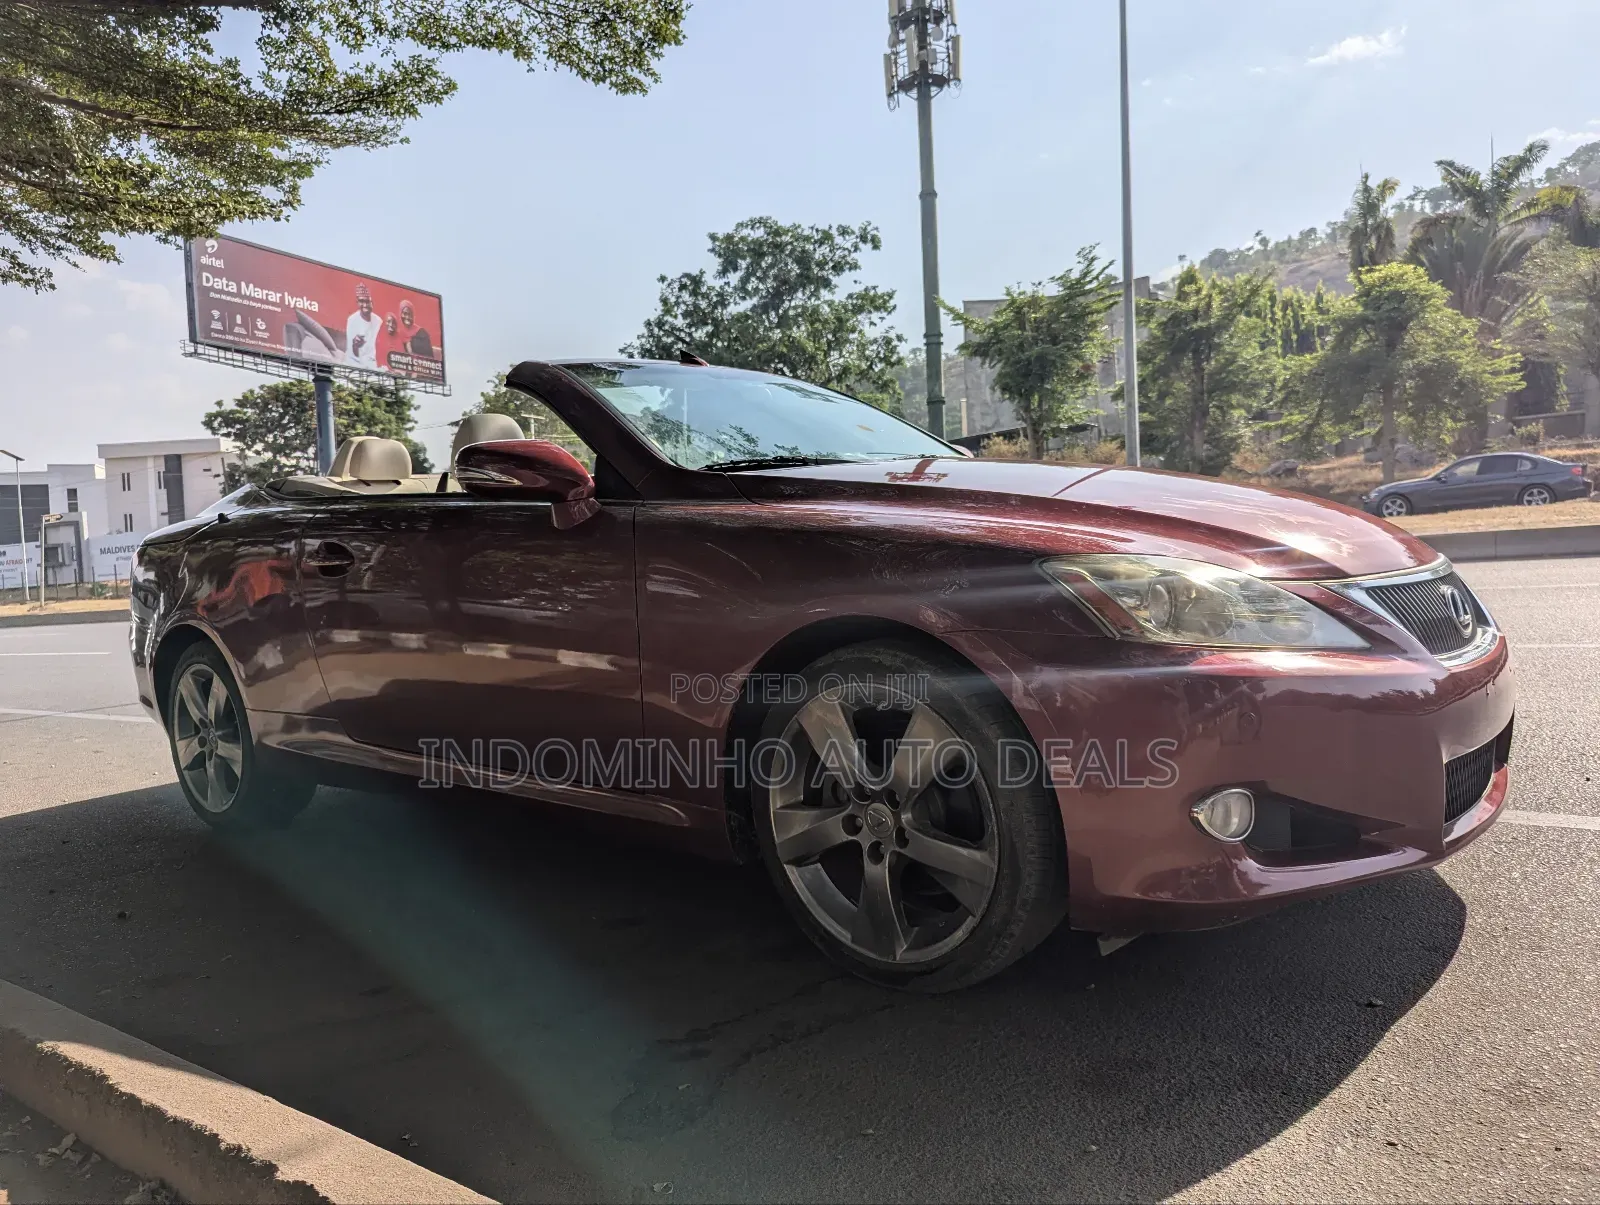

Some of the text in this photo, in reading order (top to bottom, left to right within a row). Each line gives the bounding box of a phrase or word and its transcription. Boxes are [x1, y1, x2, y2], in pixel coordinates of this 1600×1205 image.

[200, 255, 224, 268] airtel
[202, 272, 319, 312] Data Marar Iyaka
[390, 354, 442, 370] smart connect
[99, 544, 135, 555] MALDIVES
